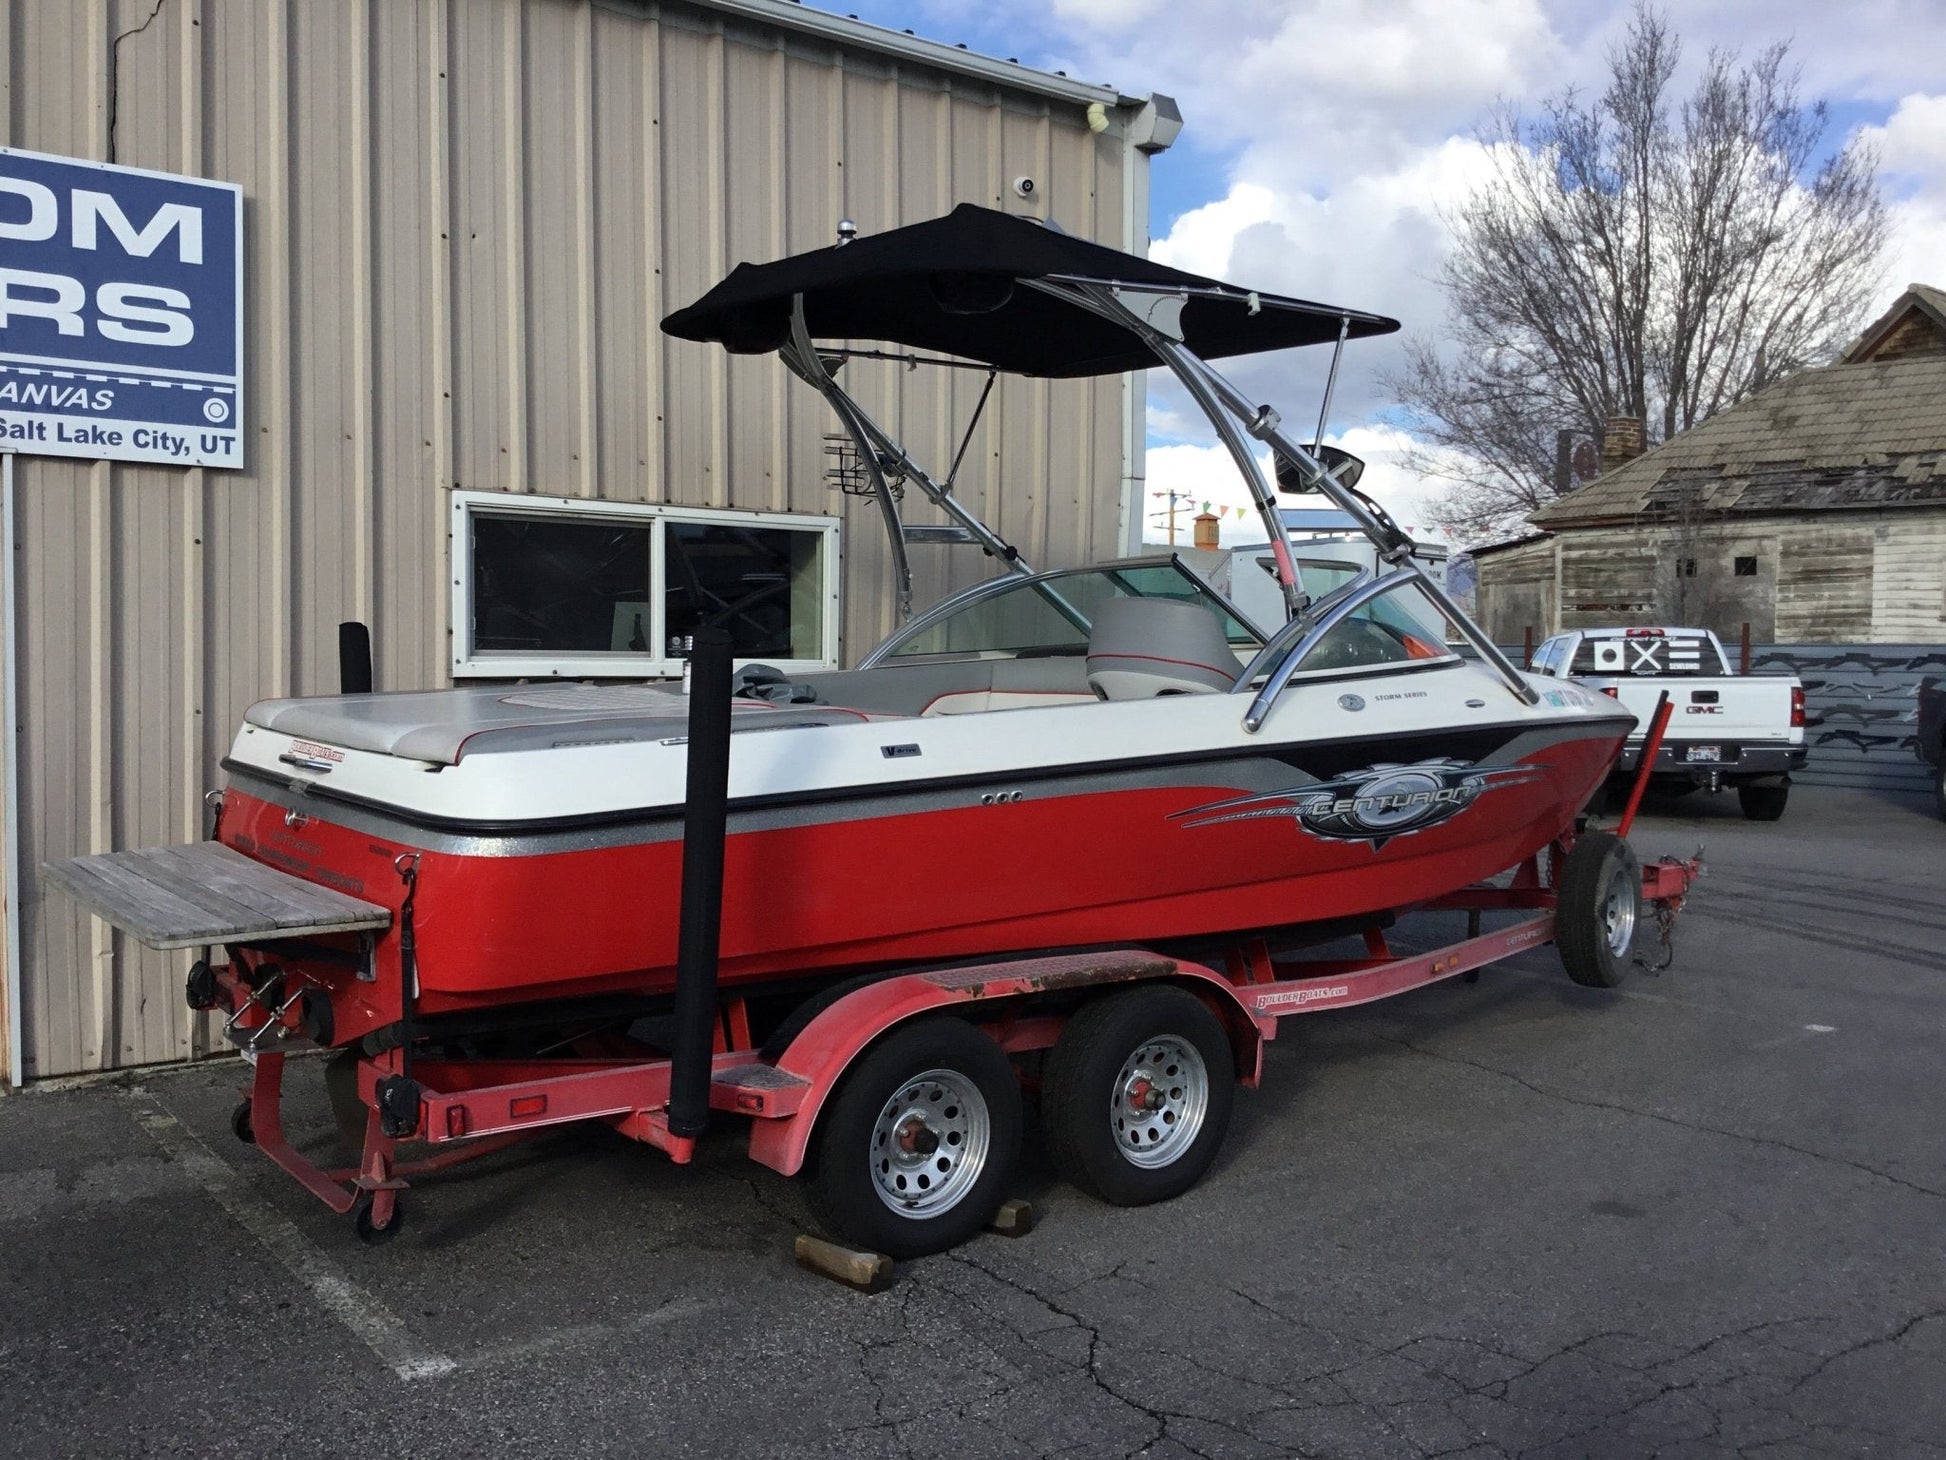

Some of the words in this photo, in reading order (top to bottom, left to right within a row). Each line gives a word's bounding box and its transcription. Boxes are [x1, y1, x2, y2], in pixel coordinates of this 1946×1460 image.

[0, 267, 194, 347] RS
[0, 381, 115, 411] ANVAS
[57, 422, 123, 446] Lake
[133, 428, 190, 456] City,
[200, 434, 236, 455] UT
[1686, 706, 1724, 715] GMC
[1312, 786, 1472, 816] CENTURION
